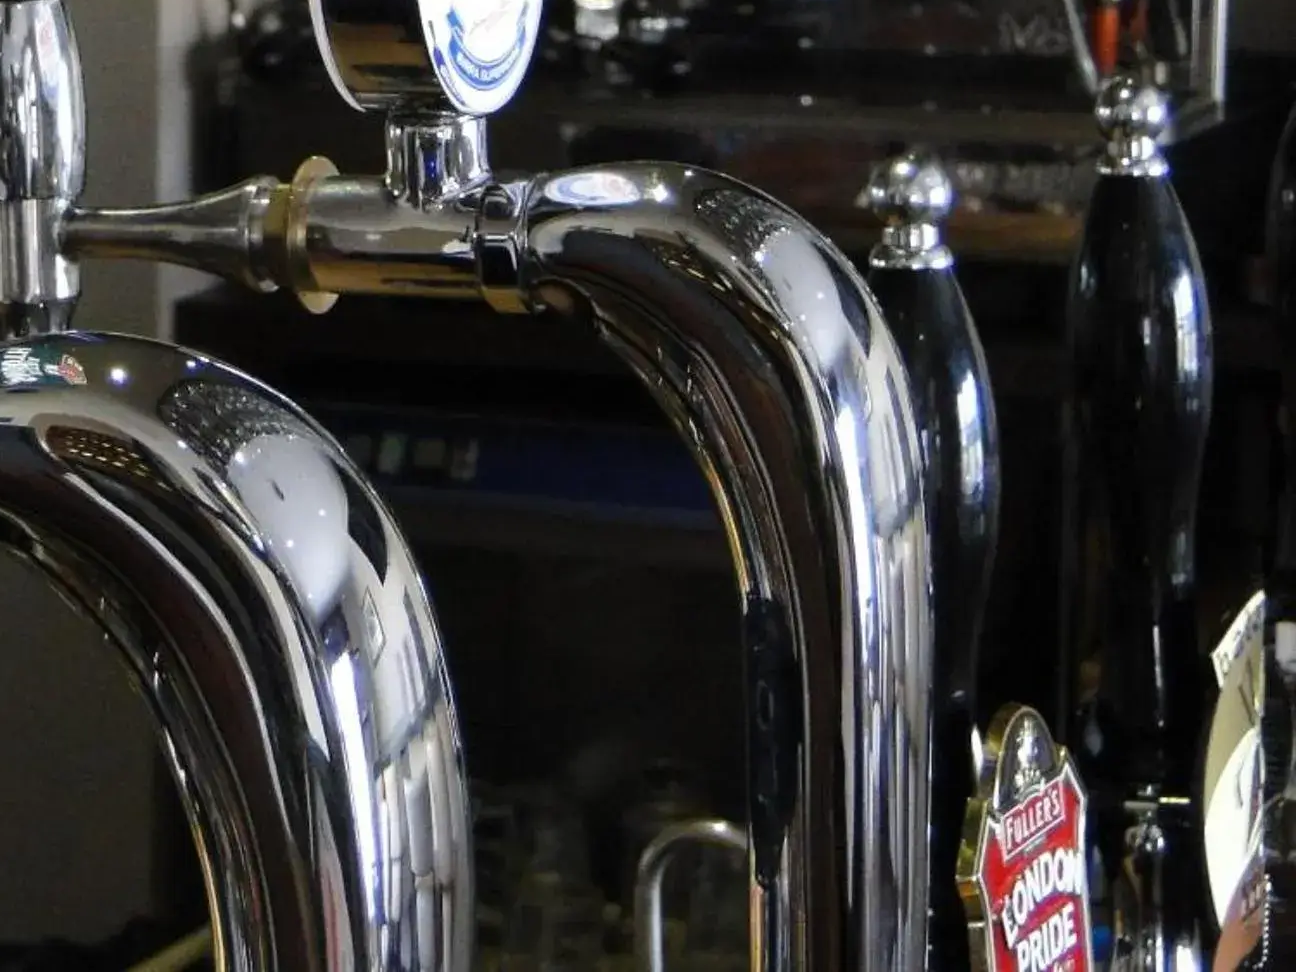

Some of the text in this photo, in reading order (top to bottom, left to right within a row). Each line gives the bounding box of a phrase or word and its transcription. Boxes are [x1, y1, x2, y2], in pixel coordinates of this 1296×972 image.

[1006, 788, 1060, 850] FULLER'S
[1002, 846, 1082, 950] LONDON
[1016, 901, 1078, 972] PRIDE
